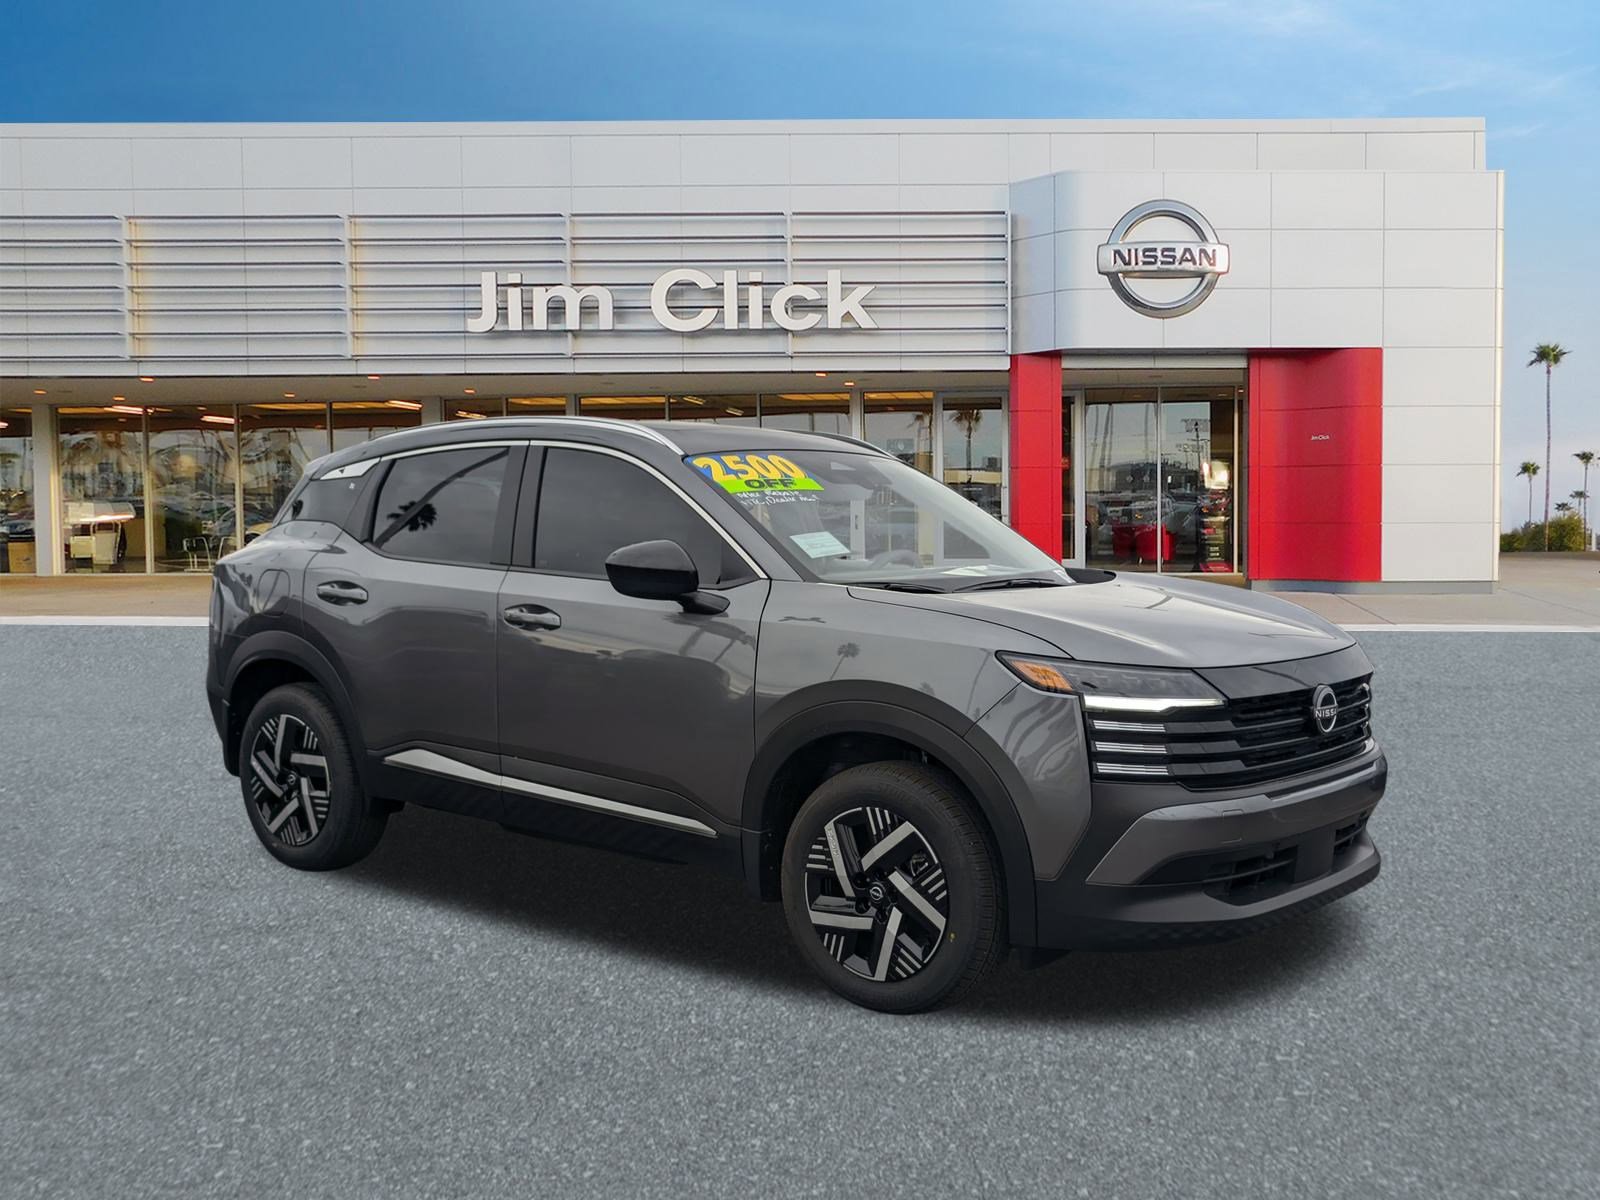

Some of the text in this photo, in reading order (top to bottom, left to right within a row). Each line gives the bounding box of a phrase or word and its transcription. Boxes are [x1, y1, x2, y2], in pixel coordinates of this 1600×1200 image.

[1112, 247, 1217, 267] NISSAN
[467, 268, 880, 333] Jim Click
[692, 454, 808, 482] 2500
[743, 478, 798, 489] OFF
